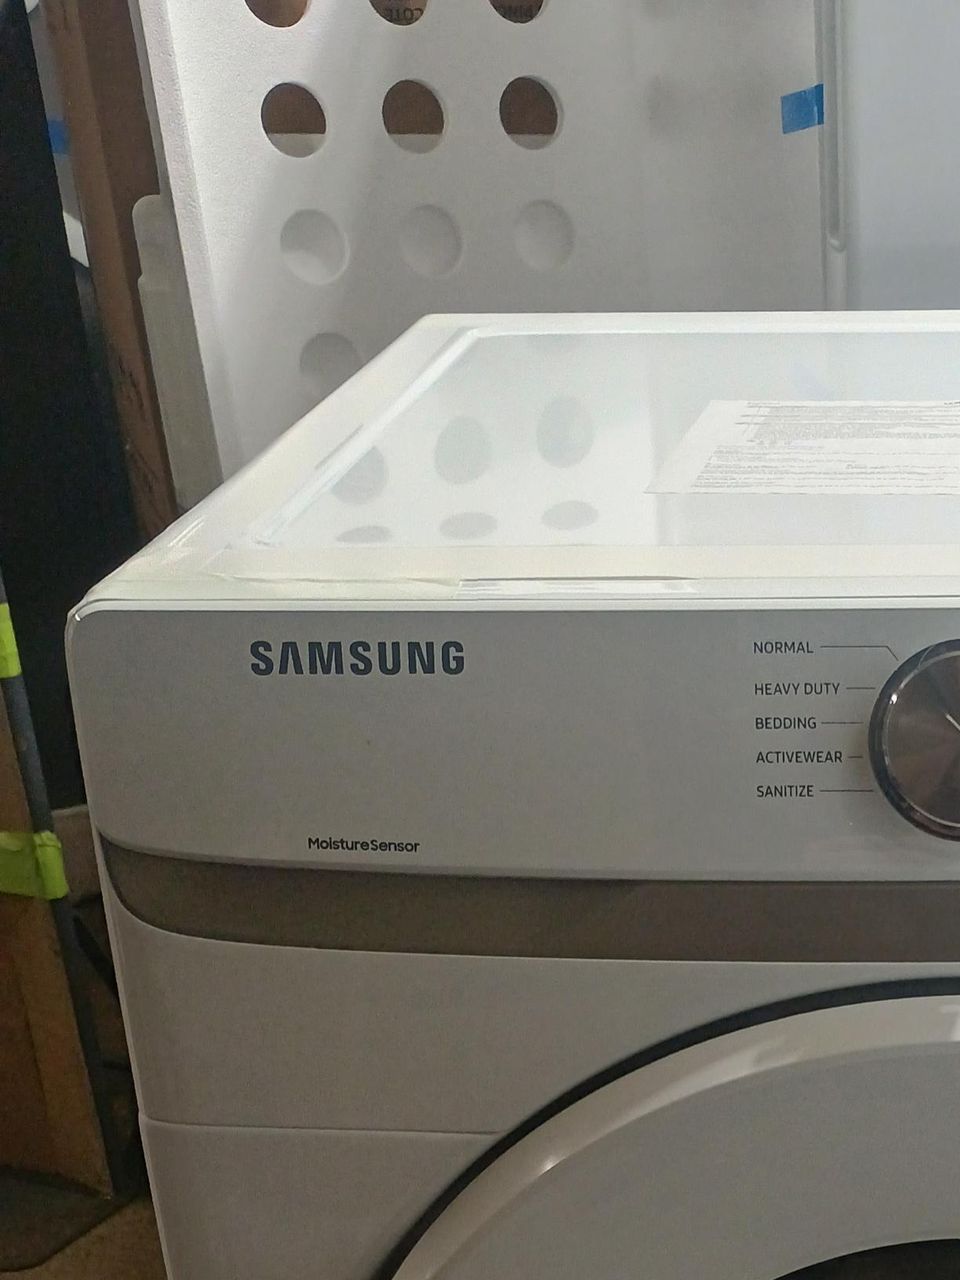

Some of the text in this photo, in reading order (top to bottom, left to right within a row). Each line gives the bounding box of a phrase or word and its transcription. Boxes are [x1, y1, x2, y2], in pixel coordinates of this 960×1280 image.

[753, 641, 813, 654] NORMAL
[250, 641, 464, 675] SAMSUNG
[754, 682, 840, 696] HEAVY DUTY
[755, 716, 816, 730] BEDDING
[755, 750, 842, 764] ACTIVEWEAR
[756, 784, 813, 798] SANITIZE
